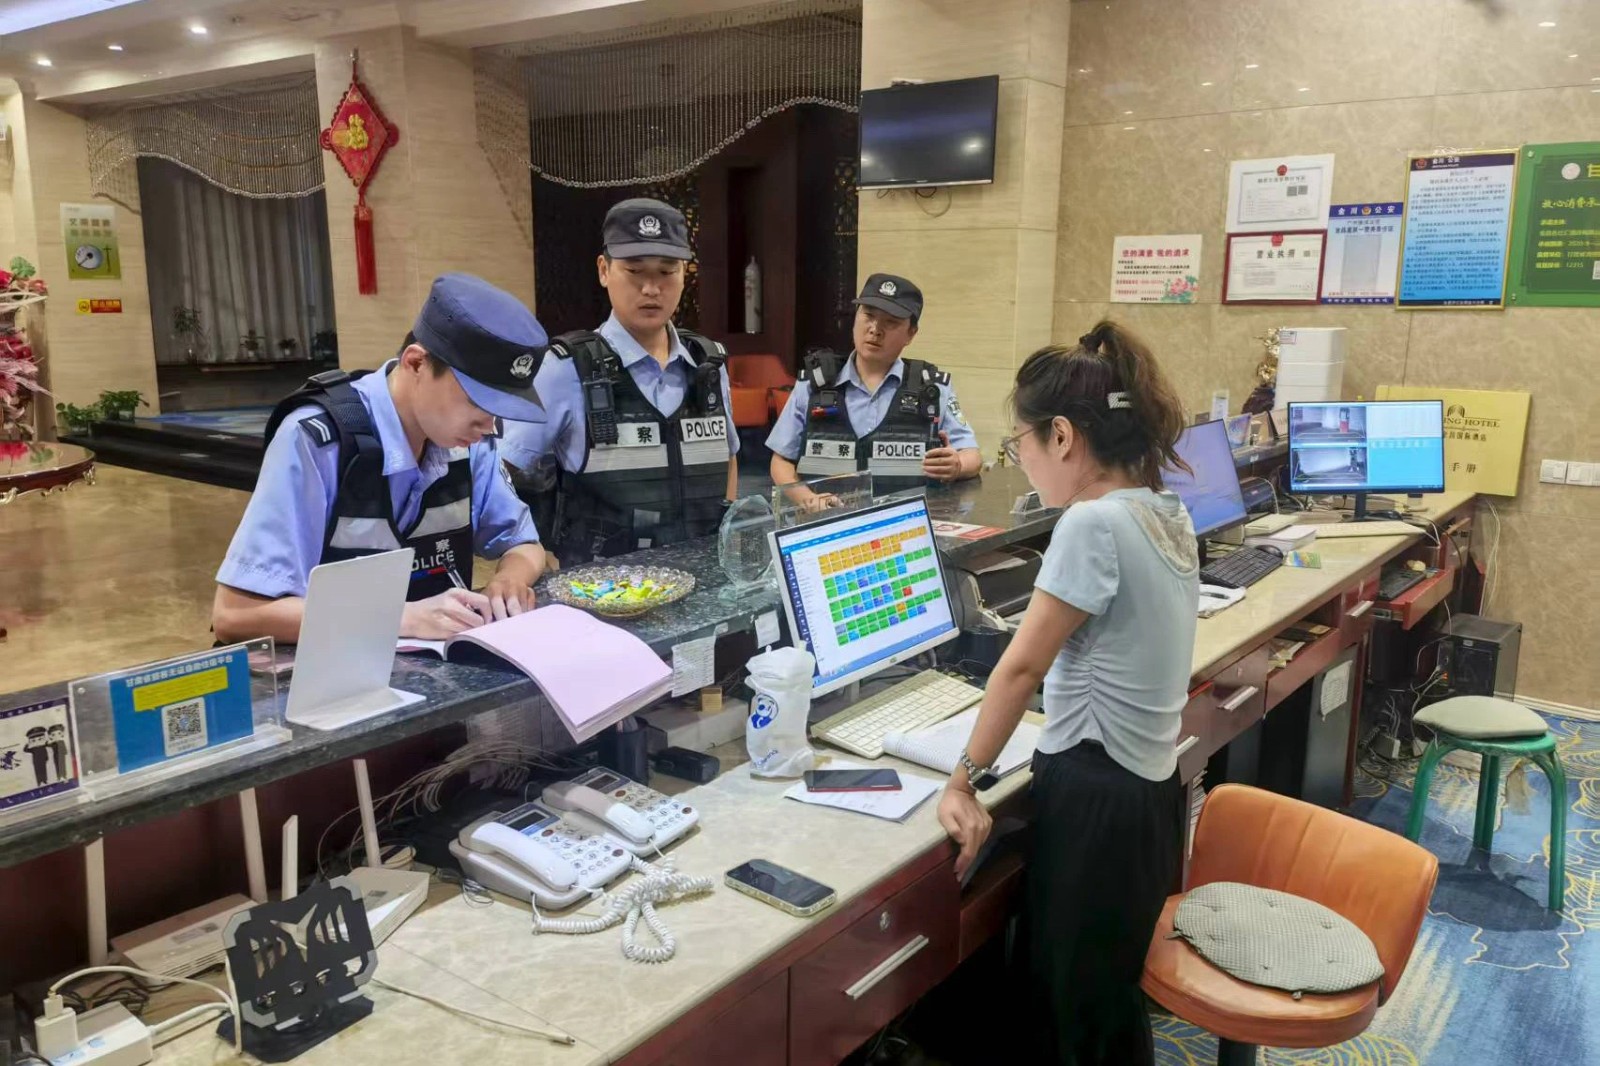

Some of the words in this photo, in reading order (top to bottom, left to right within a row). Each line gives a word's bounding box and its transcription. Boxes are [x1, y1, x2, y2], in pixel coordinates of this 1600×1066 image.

[686, 420, 725, 438] POLICE
[1464, 419, 1500, 428] HOTEL
[637, 426, 653, 443] 察
[812, 441, 850, 456] 警察
[877, 443, 921, 457] POLICE
[435, 538, 450, 553] 察
[411, 550, 455, 571] OLICE
